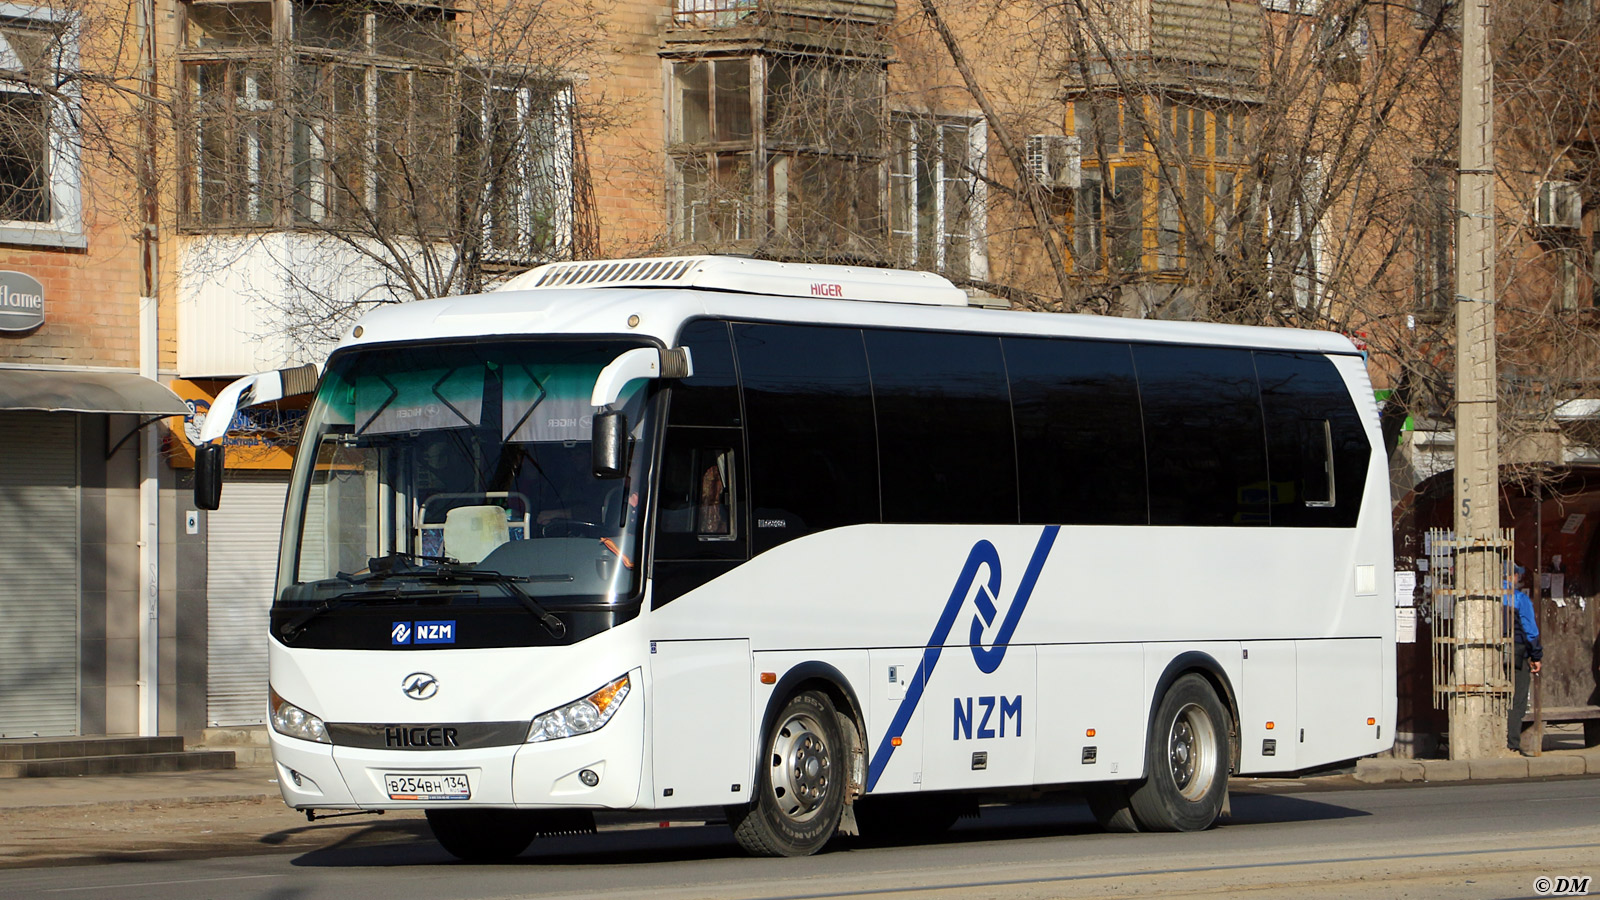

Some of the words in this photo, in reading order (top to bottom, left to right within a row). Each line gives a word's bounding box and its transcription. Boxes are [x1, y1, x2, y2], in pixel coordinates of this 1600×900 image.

[810, 283, 843, 297] HIGER
[1461, 498, 1472, 517] 5
[417, 625, 452, 639] NZM
[953, 695, 1023, 741] NZM
[385, 727, 459, 747] HIGER
[390, 777, 442, 793] В254ВН
[443, 776, 464, 789] 134
